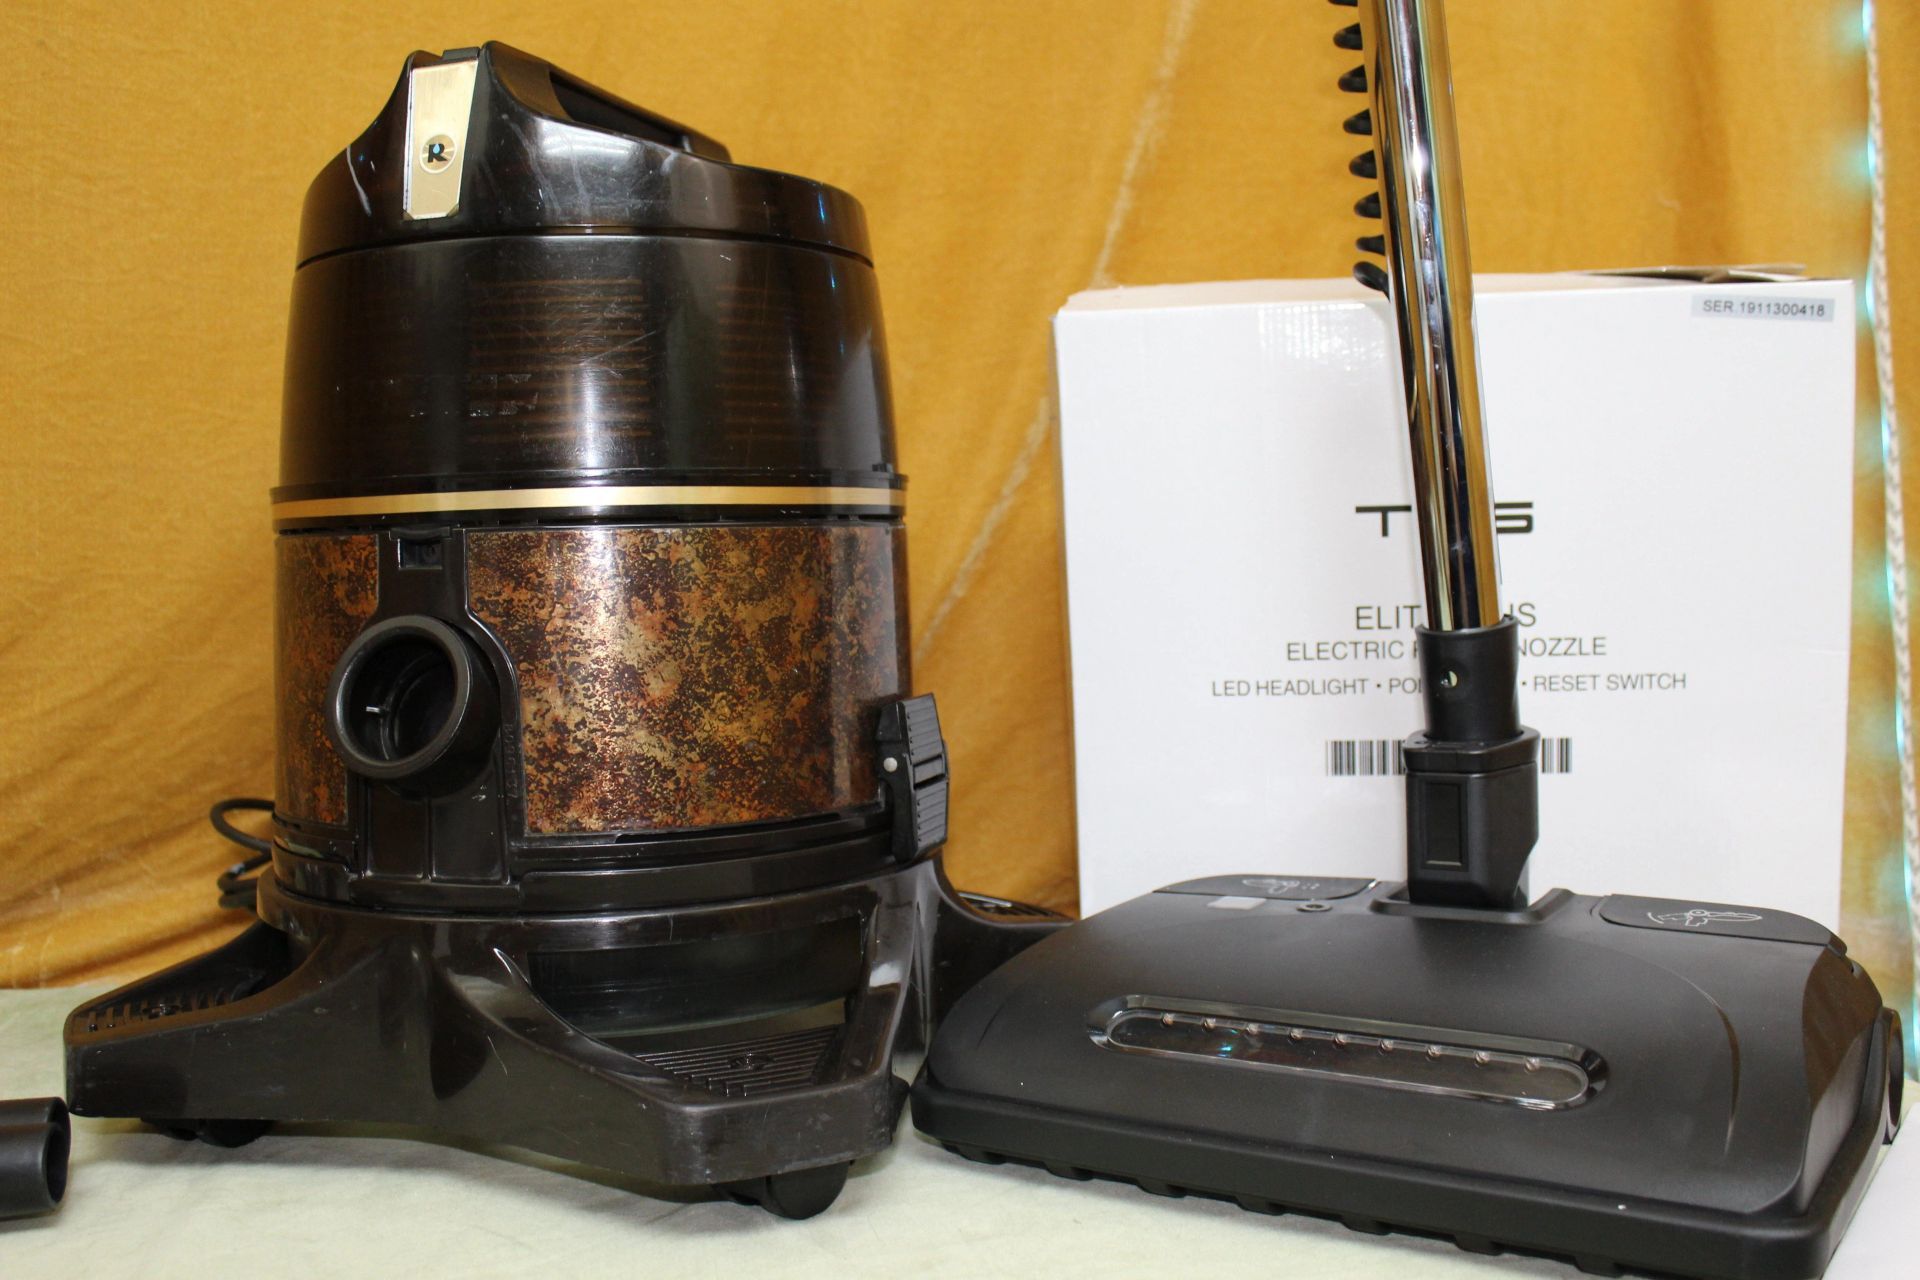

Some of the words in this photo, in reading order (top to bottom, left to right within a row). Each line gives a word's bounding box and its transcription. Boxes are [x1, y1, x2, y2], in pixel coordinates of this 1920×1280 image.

[427, 143, 448, 163] R
[1703, 299, 1735, 313] SER
[1740, 301, 1825, 318] 1911300418
[1355, 502, 1534, 537] TS
[1355, 603, 1423, 630] ELIT
[1286, 640, 1405, 661] ELECTRIC
[1211, 680, 1251, 697] LED
[1256, 678, 1369, 697] HEADLIGHT
[1533, 674, 1600, 691] RESET
[1606, 673, 1687, 690] SWITCH
